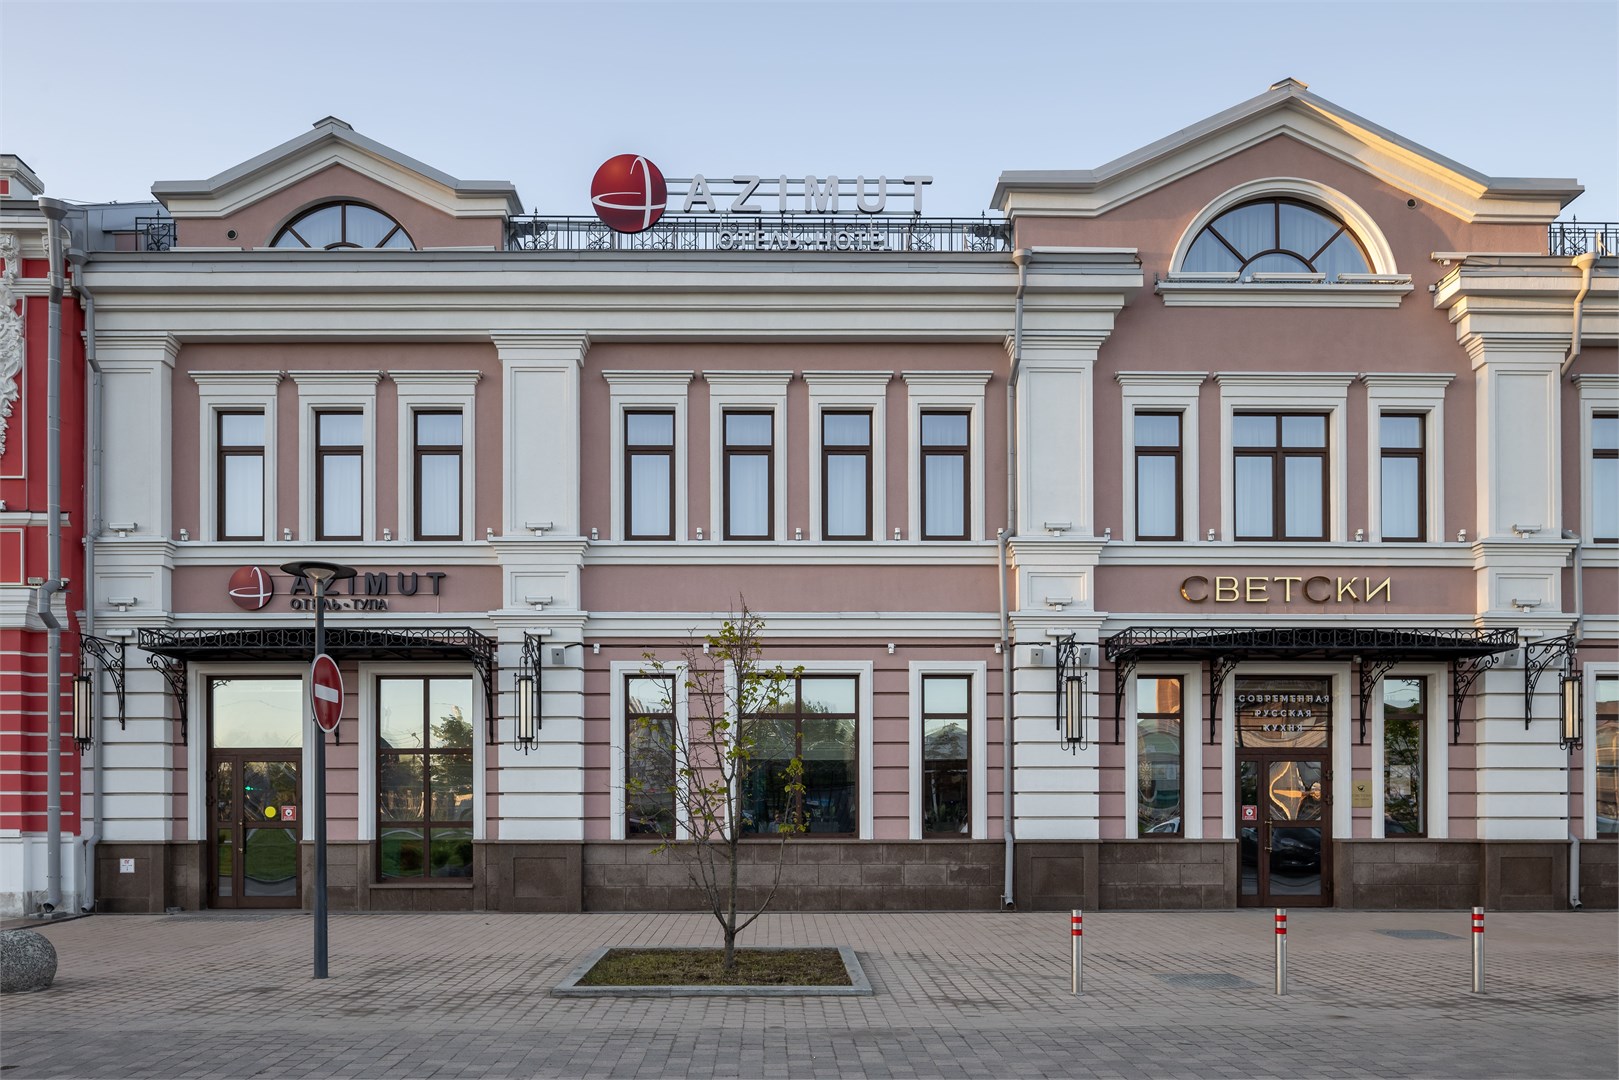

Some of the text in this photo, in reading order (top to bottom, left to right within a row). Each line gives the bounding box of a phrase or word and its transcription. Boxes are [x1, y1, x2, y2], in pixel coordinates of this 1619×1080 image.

[684, 174, 933, 214] AZIMUT
[1180, 575, 1391, 603] СВЕТСКИ
[290, 598, 342, 611] ОТЛЬ
[1238, 694, 1330, 703] СОВРЕМЕННАЯ
[1254, 709, 1312, 718] РУССКАЯ
[1262, 723, 1304, 732] КУХНЯ
